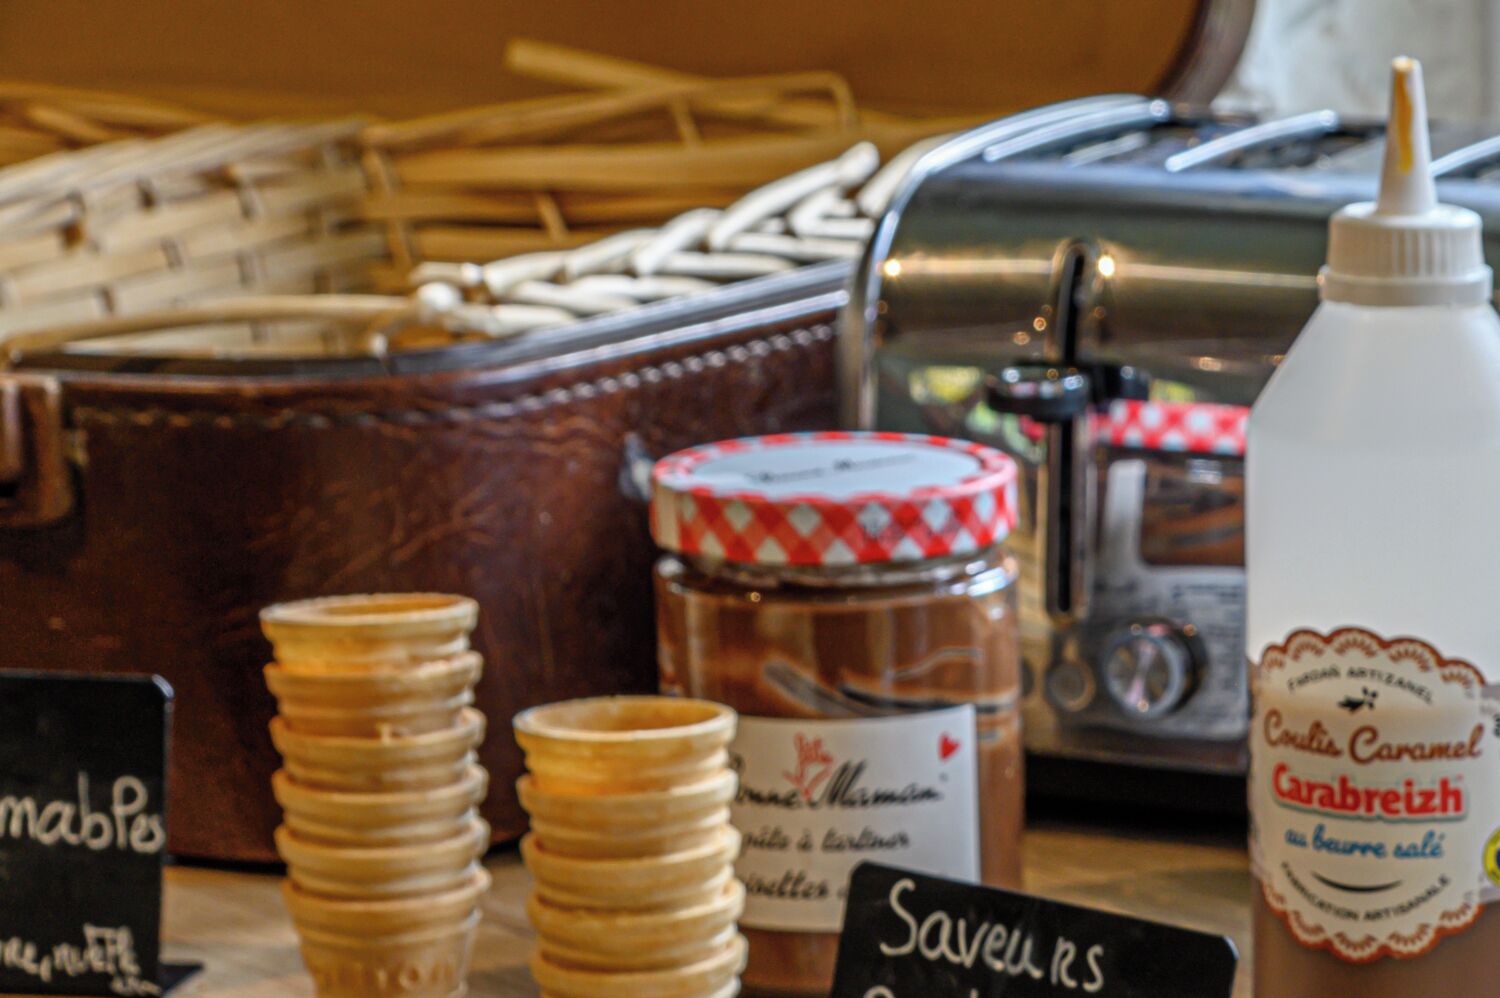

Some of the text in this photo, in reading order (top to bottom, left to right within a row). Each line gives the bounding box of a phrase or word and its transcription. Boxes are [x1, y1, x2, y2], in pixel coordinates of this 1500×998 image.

[1264, 709, 1486, 765] Coulis Caramel
[1272, 762, 1463, 816] Carabreizh
[1285, 823, 1447, 859] au beurre salé
[880, 879, 1105, 992] Saveurs
